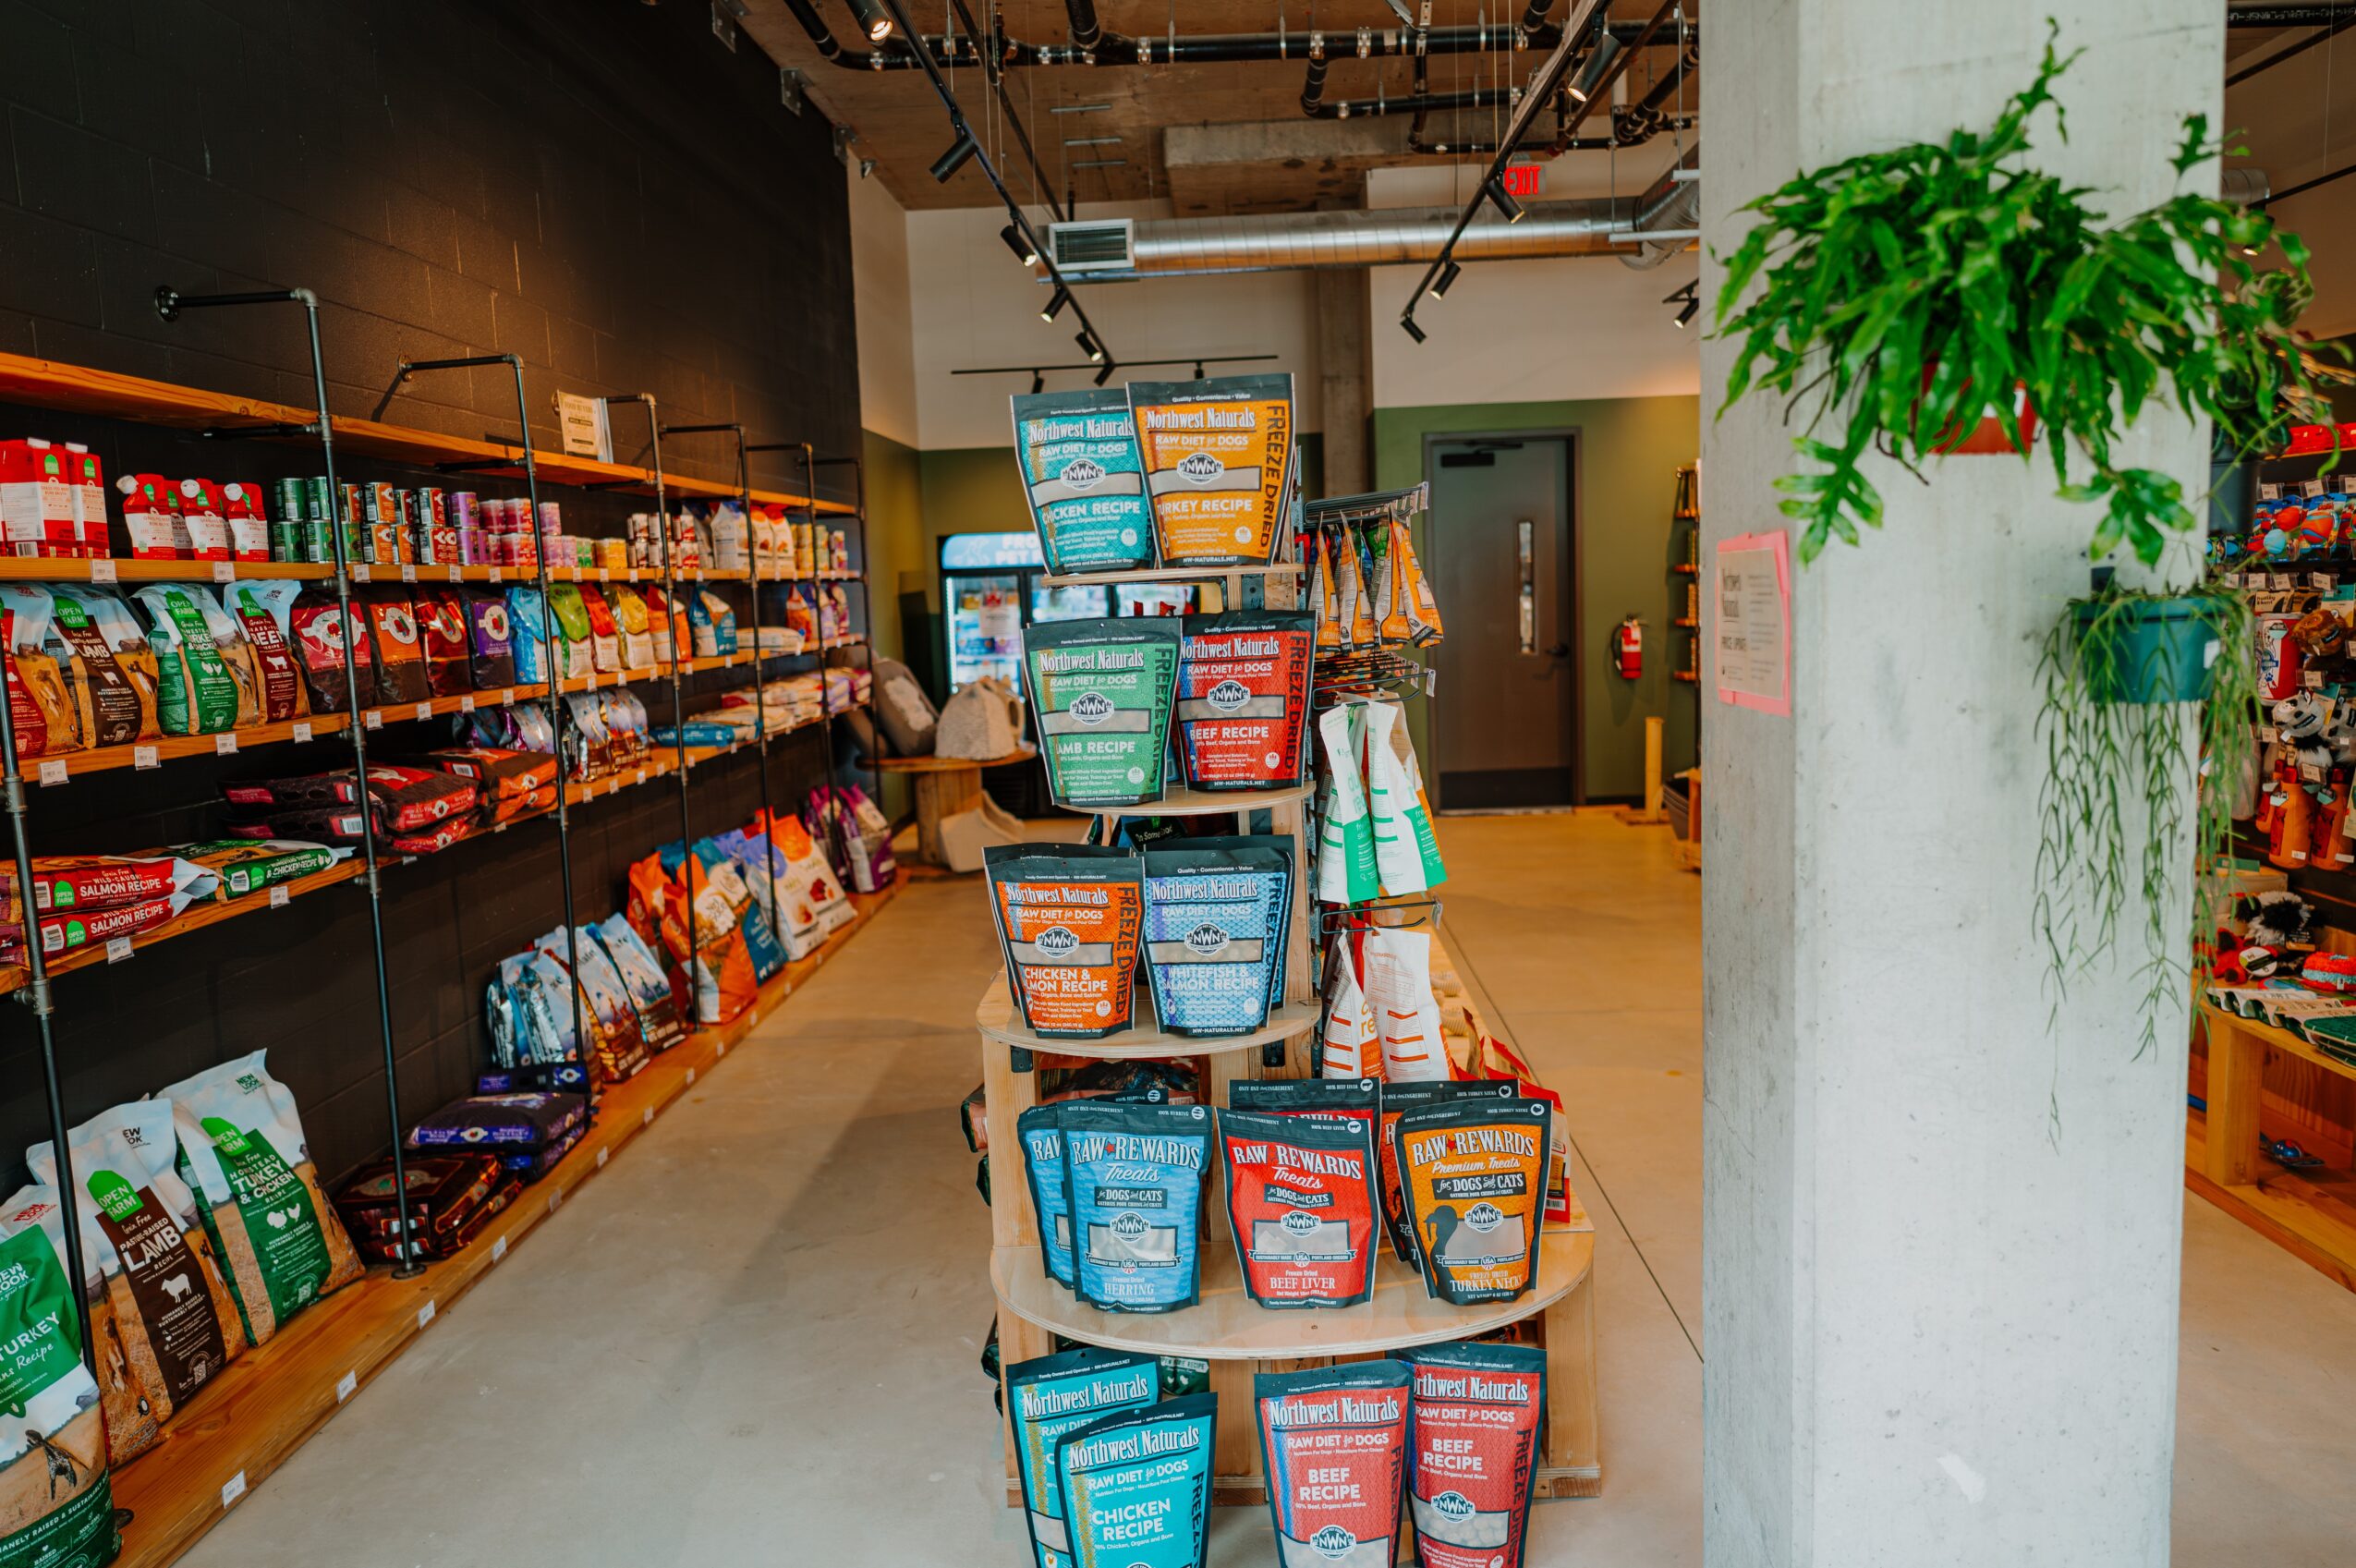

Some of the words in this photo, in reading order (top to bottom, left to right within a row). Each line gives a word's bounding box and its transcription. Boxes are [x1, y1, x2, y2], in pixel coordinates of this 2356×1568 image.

[1504, 165, 1541, 196] EXIT
[1147, 409, 1204, 429] Northwest
[1207, 407, 1256, 429] Naturals
[1028, 420, 1084, 444] Northwest
[1087, 417, 1134, 438] Naturals
[1156, 435, 1180, 444] RAW
[1182, 435, 1205, 444] DIET
[1218, 435, 1248, 444] DOGS
[1266, 406, 1286, 480] FREEZE
[1069, 468, 1097, 481] NWN
[1186, 461, 1215, 475] NWN
[1042, 504, 1087, 525] CHICKEN
[1092, 502, 1141, 515] RECIPE
[1158, 500, 1198, 516] TURKEY
[1201, 500, 1252, 512] RECIPE
[1259, 483, 1278, 548] DRIED
[251, 630, 283, 646] BEEF
[1181, 640, 1232, 660] Northwest
[1233, 637, 1279, 657] Naturals
[1040, 652, 1095, 672] Northwest
[1098, 649, 1144, 669] Naturals
[1187, 664, 1208, 675] RAW
[1210, 663, 1233, 674] DIET
[1244, 662, 1272, 673] DOGS
[1289, 636, 1308, 706] FREEZE
[1050, 677, 1071, 687] RAW
[1074, 675, 1096, 686] DIET
[1108, 675, 1136, 685] DOGS
[1216, 687, 1242, 700] NWN
[1078, 700, 1105, 713] NWN
[1190, 727, 1217, 740] BEEF
[1221, 726, 1269, 738] RECIPE
[1284, 711, 1300, 770] DRIED
[80, 882, 127, 897] SALMON
[128, 879, 162, 891] RECIPE
[1005, 886, 1061, 904] Northwest
[1063, 888, 1109, 905] Naturals
[1152, 881, 1208, 900] Northwest
[1210, 879, 1257, 899] Naturals
[91, 914, 133, 934] SALMON
[135, 905, 164, 921] RECIPE
[1017, 909, 1038, 918] RAW
[1040, 909, 1063, 919] DIET
[1075, 910, 1103, 919] DOGS
[1117, 887, 1138, 951] FREEZE
[68, 930, 84, 939] OPEN
[1044, 933, 1072, 946] NWN
[1193, 930, 1220, 943] NWN
[1025, 968, 1077, 980] CHICKEN
[1081, 969, 1090, 979] &
[1168, 966, 1235, 978] WHITEFISH
[1239, 966, 1248, 978] &
[1115, 955, 1136, 1015] DRIED
[1165, 978, 1209, 991] SALMON
[1214, 978, 1259, 991] RECIPE
[236, 1073, 256, 1086] NEW
[1073, 1136, 1108, 1165] RAW
[1114, 1137, 1200, 1170] REWARDS
[1413, 1134, 1447, 1167] RAW
[1454, 1130, 1535, 1158] REWARDS
[1233, 1145, 1269, 1164] RAW
[1276, 1145, 1362, 1180] REWARDS
[1432, 1161, 1486, 1174] Premium
[1488, 1157, 1521, 1170] Treats
[233, 1160, 285, 1193] TURKEY
[1105, 1163, 1160, 1182] Treats
[1272, 1166, 1323, 1189] Treats
[1436, 1181, 1451, 1194] for
[1452, 1176, 1482, 1192] DOGS
[1483, 1175, 1497, 1189] and
[1498, 1174, 1524, 1188] CATS
[98, 1184, 130, 1209] OPEN
[239, 1193, 251, 1205] &
[107, 1197, 138, 1218] FARM
[1472, 1209, 1496, 1222] NWN
[135, 1214, 152, 1226] Free
[1117, 1220, 1143, 1232] NWN
[1288, 1219, 1314, 1228] NWN
[123, 1225, 181, 1272] LAMB
[153, 1255, 175, 1270] RECIPE
[1104, 1283, 1154, 1295] HERRING
[1269, 1278, 1298, 1289] BEEF
[1302, 1278, 1335, 1289] LIVER
[1450, 1279, 1494, 1292] TURKEY
[1497, 1274, 1522, 1290] NECKS
[16, 1343, 54, 1369] Recipe
[1023, 1388, 1090, 1418] Northwest
[1092, 1374, 1148, 1406] Naturals
[1269, 1397, 1339, 1428] Northwest
[1342, 1395, 1400, 1425] Naturals
[1415, 1405, 1439, 1419] RAW
[1441, 1408, 1467, 1419] DIET
[1481, 1409, 1514, 1422] DOGS
[1069, 1440, 1140, 1469] Northwest
[1141, 1427, 1199, 1455] Naturals
[1287, 1437, 1313, 1449] RAW
[1316, 1435, 1342, 1447] DIET
[1355, 1433, 1389, 1446] DOGS
[1432, 1439, 1474, 1453] BEEF
[1423, 1452, 1483, 1471] RECIPE
[1087, 1475, 1114, 1490] RAW
[1117, 1469, 1143, 1484] DIET
[1156, 1459, 1189, 1477] DOGS
[1308, 1468, 1350, 1484] BEEF
[1299, 1484, 1361, 1501] RECIPE
[1091, 1498, 1171, 1525] CHICKEN
[1439, 1498, 1466, 1513] NWN
[1103, 1518, 1164, 1541] RECIPE
[1106, 1540, 1129, 1550] Chicken,
[1131, 1538, 1149, 1549] Organs
[1160, 1533, 1174, 1542] Bone
[1319, 1533, 1347, 1550] NWN
[34, 1549, 56, 1565] RAISED
